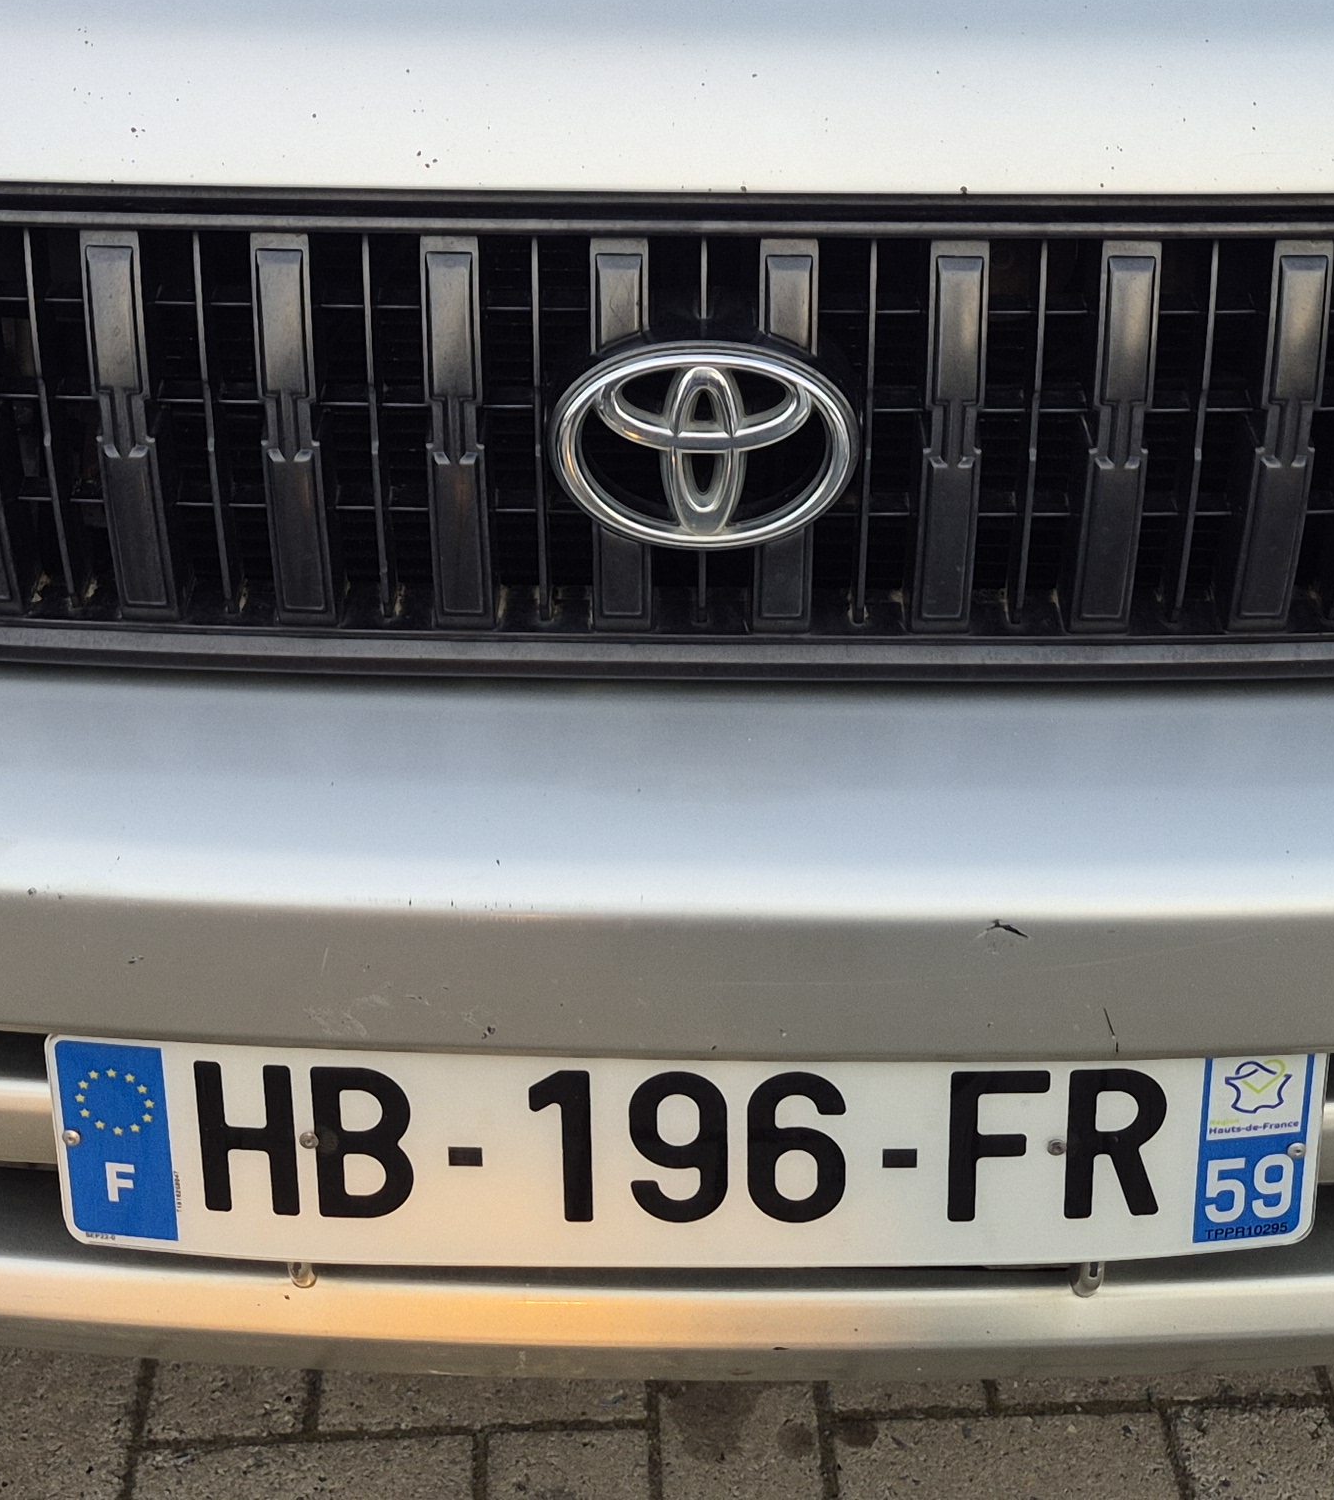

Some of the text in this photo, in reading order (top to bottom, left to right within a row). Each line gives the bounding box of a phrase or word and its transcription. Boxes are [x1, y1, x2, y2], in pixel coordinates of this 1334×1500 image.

[1208, 1120, 1300, 1136] Hauts-de-France
[104, 1161, 136, 1203] F
[1204, 1153, 1295, 1223] 59
[1205, 1221, 1289, 1241] TPPR10295
